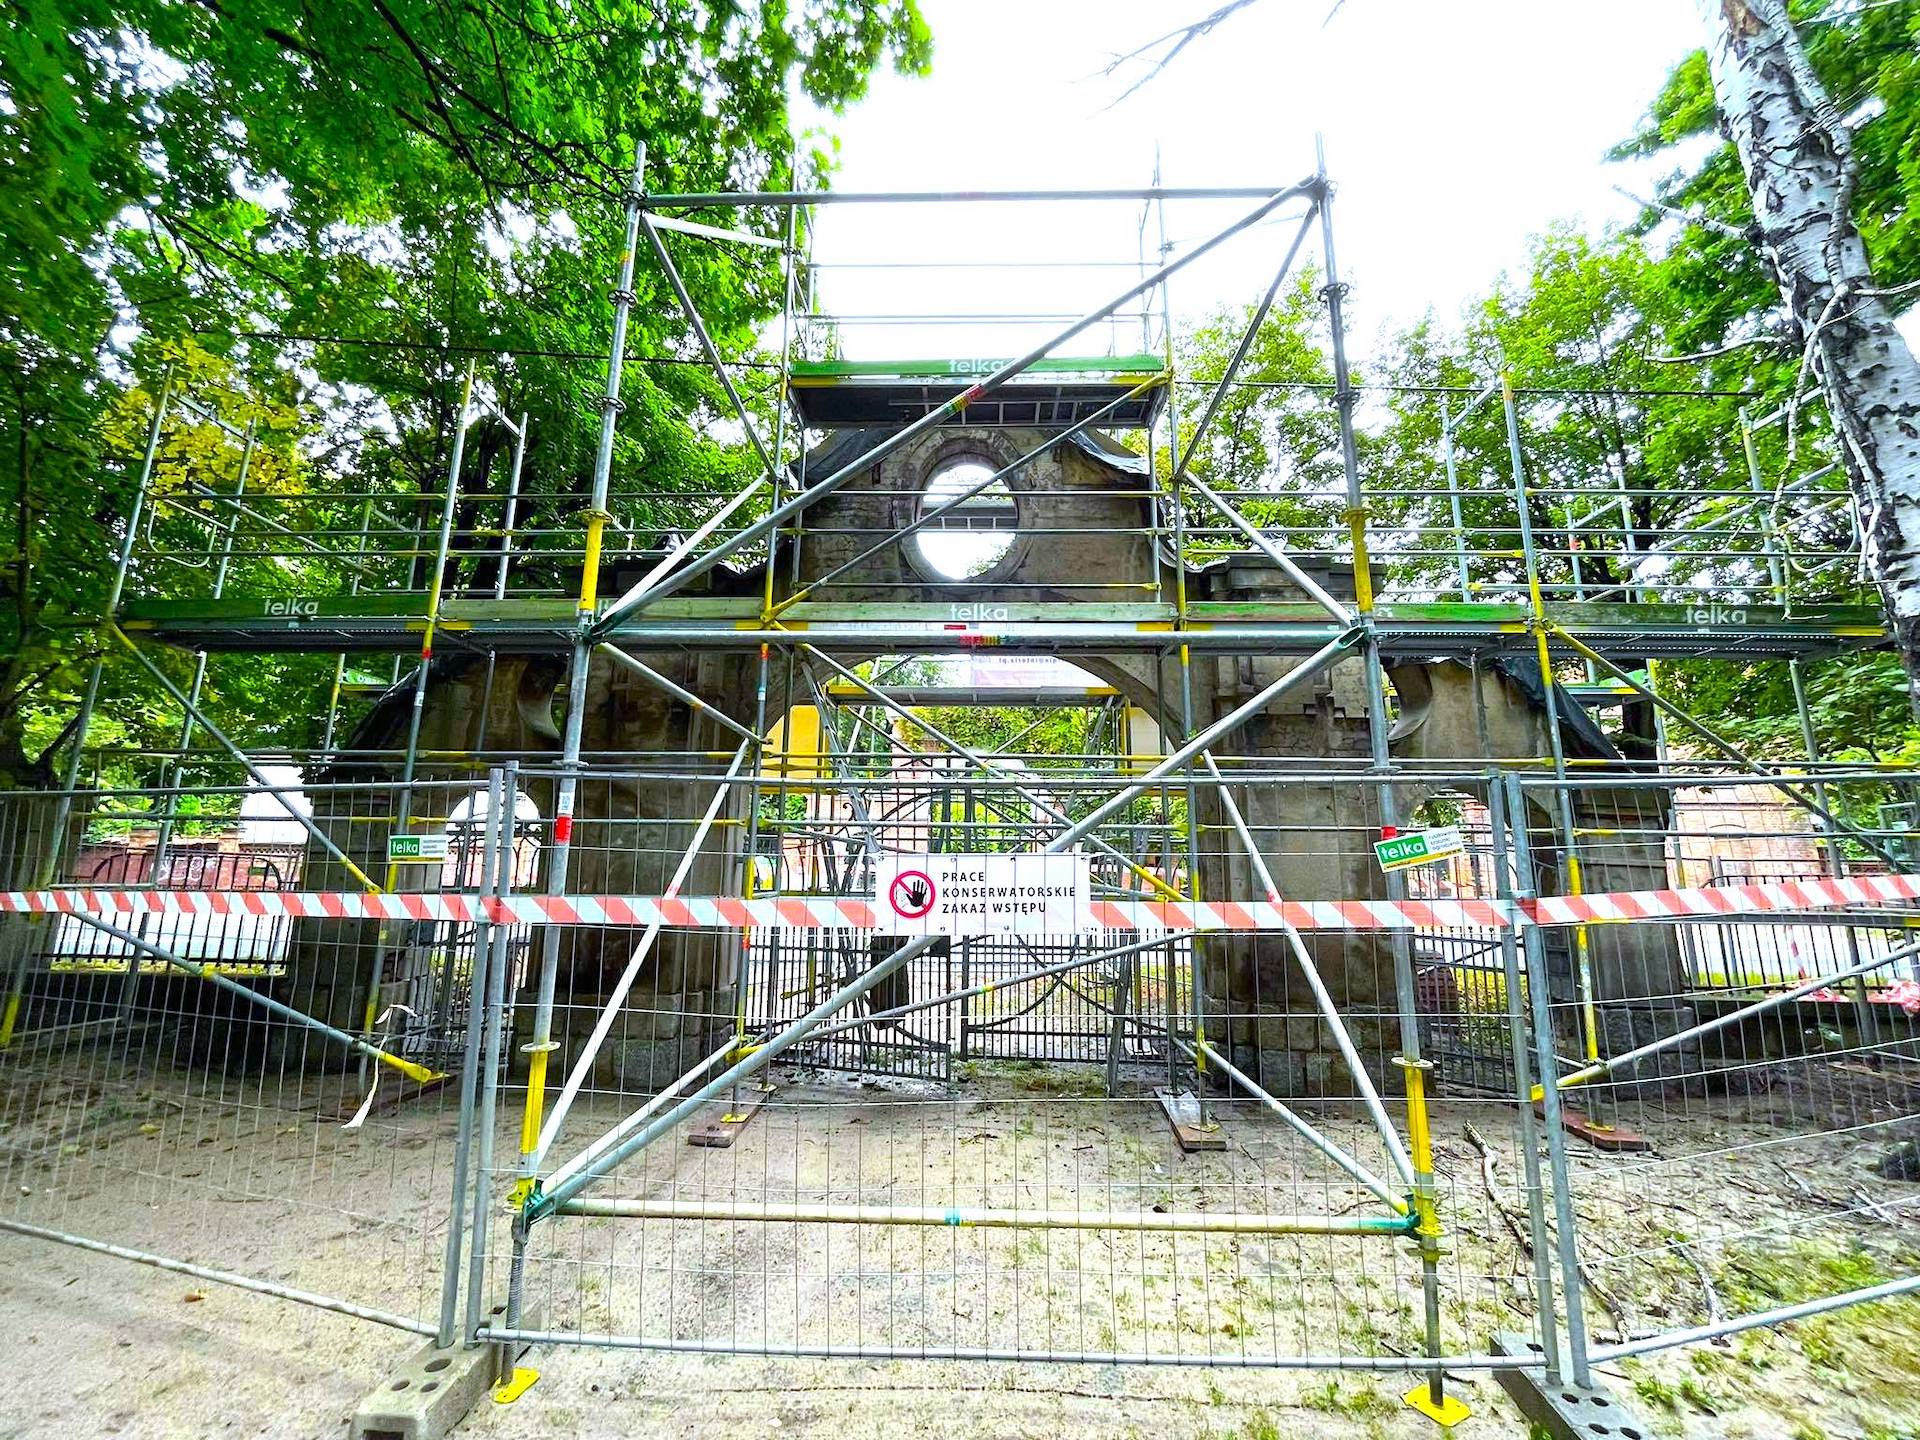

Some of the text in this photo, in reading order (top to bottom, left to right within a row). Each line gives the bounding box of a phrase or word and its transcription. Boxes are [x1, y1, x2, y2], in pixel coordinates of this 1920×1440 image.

[949, 359, 1004, 373] telka
[263, 598, 319, 616] telka
[950, 603, 1009, 621] telka
[1685, 604, 1747, 625] telka
[391, 840, 419, 854] telka
[1380, 841, 1425, 860] telka
[942, 871, 985, 883] PRACE
[942, 886, 1076, 898] KONSERWATORSKIE
[942, 902, 1047, 916] ZAKAZ WSTĘPU
